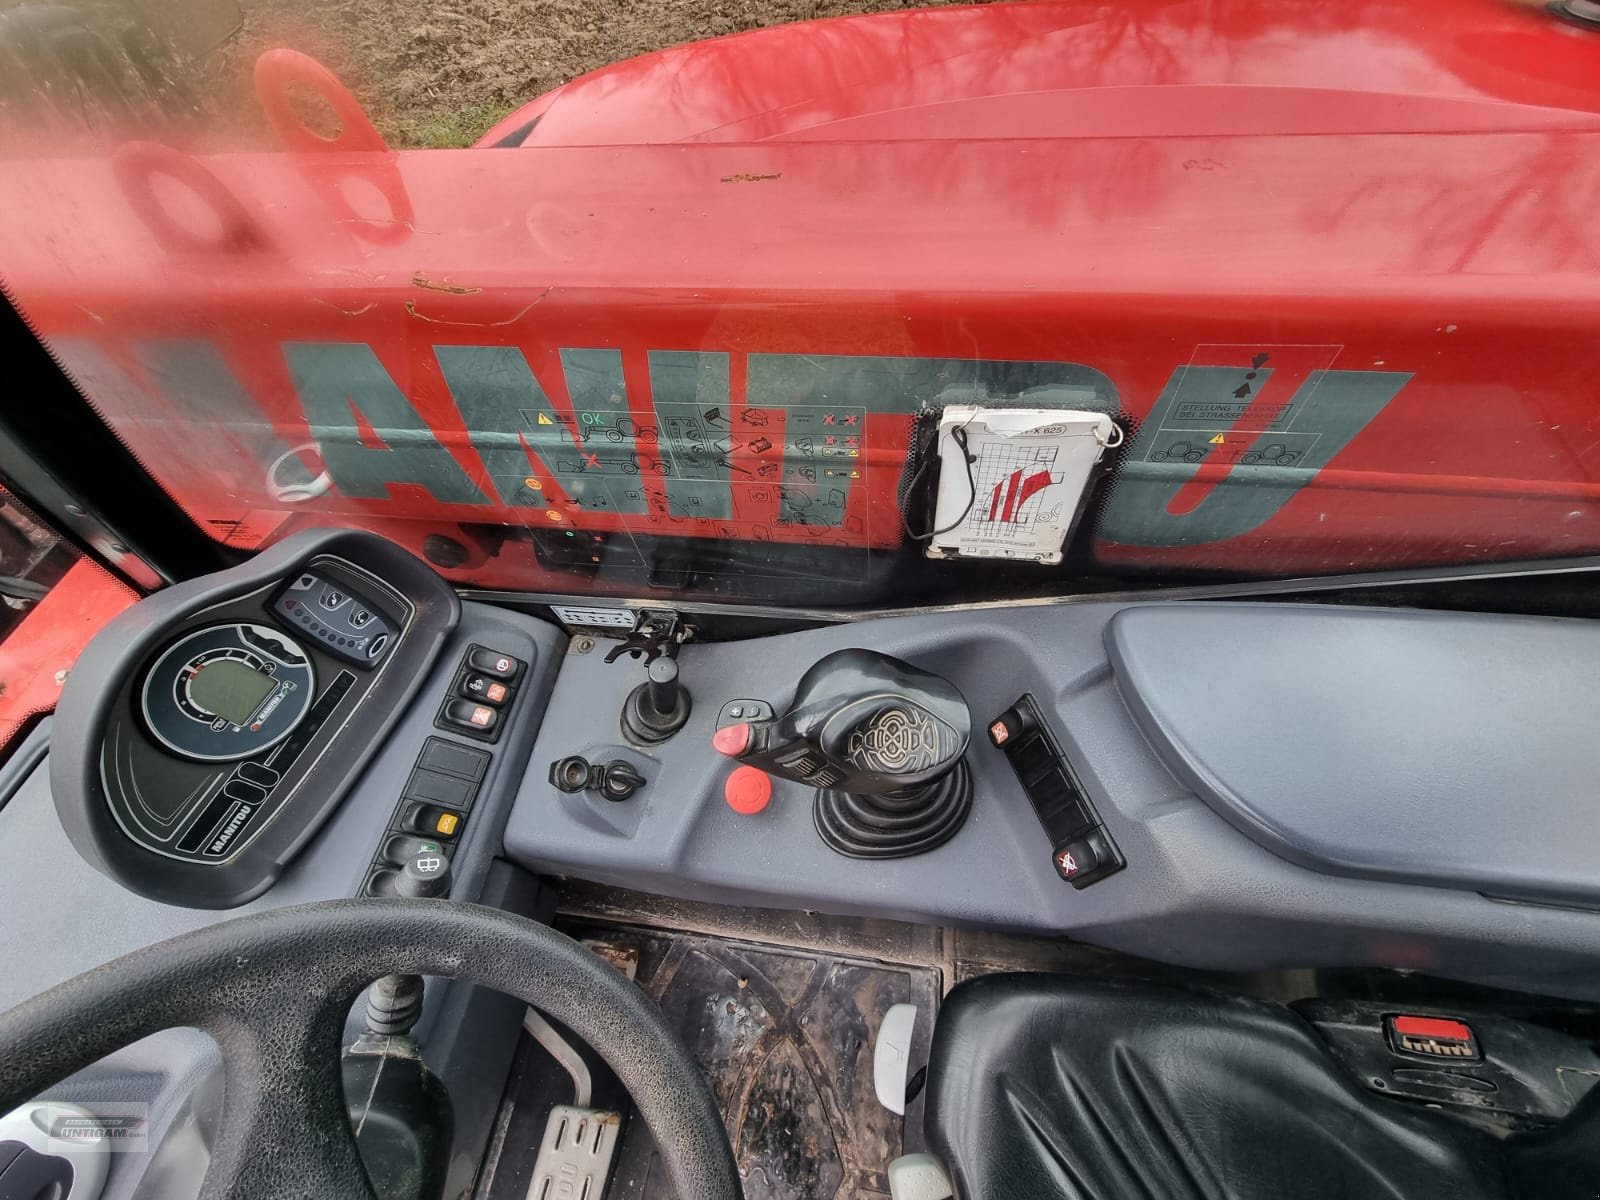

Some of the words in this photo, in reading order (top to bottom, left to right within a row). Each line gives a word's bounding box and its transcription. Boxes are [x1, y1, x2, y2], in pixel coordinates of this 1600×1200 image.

[1182, 404, 1231, 412] STELLUNG
[581, 412, 605, 425] OK
[1043, 426, 1063, 434] 625
[211, 804, 251, 853] MANITOU
